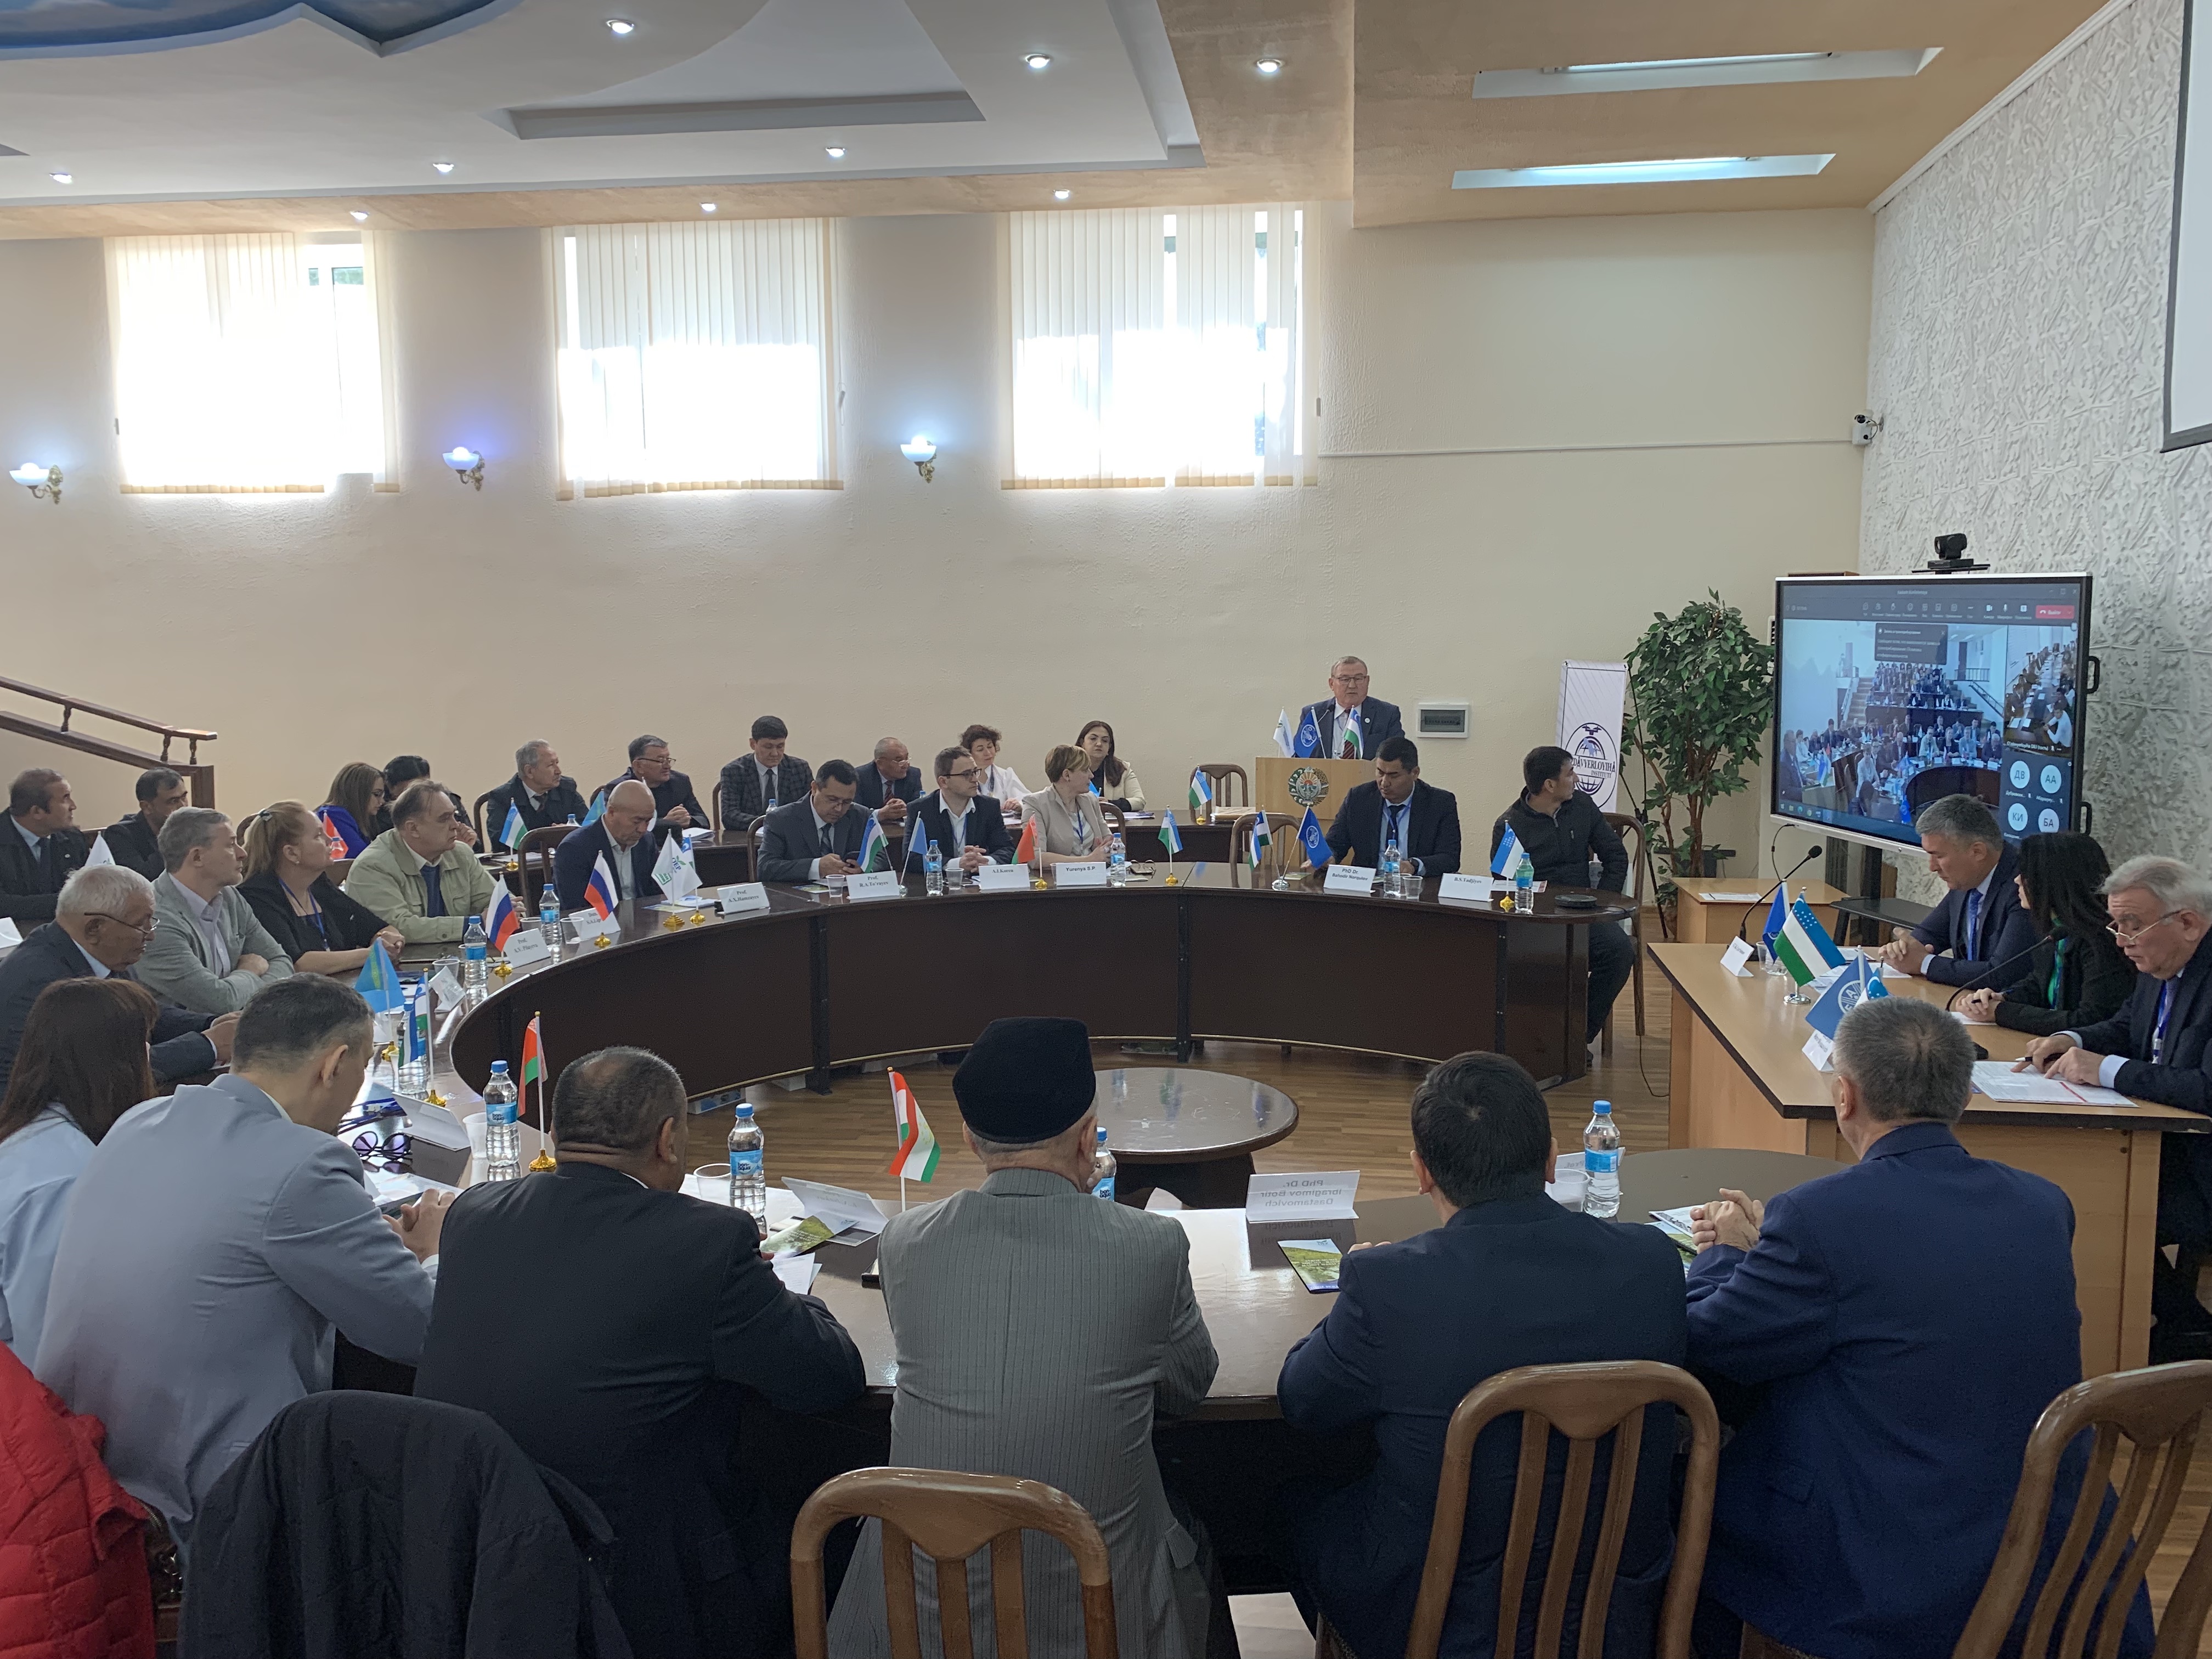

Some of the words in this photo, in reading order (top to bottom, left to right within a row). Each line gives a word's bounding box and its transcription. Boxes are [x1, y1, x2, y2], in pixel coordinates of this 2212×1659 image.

[2014, 770, 2025, 780] ДВ
[2012, 812, 2023, 822] КИ
[2044, 818, 2054, 828] БА
